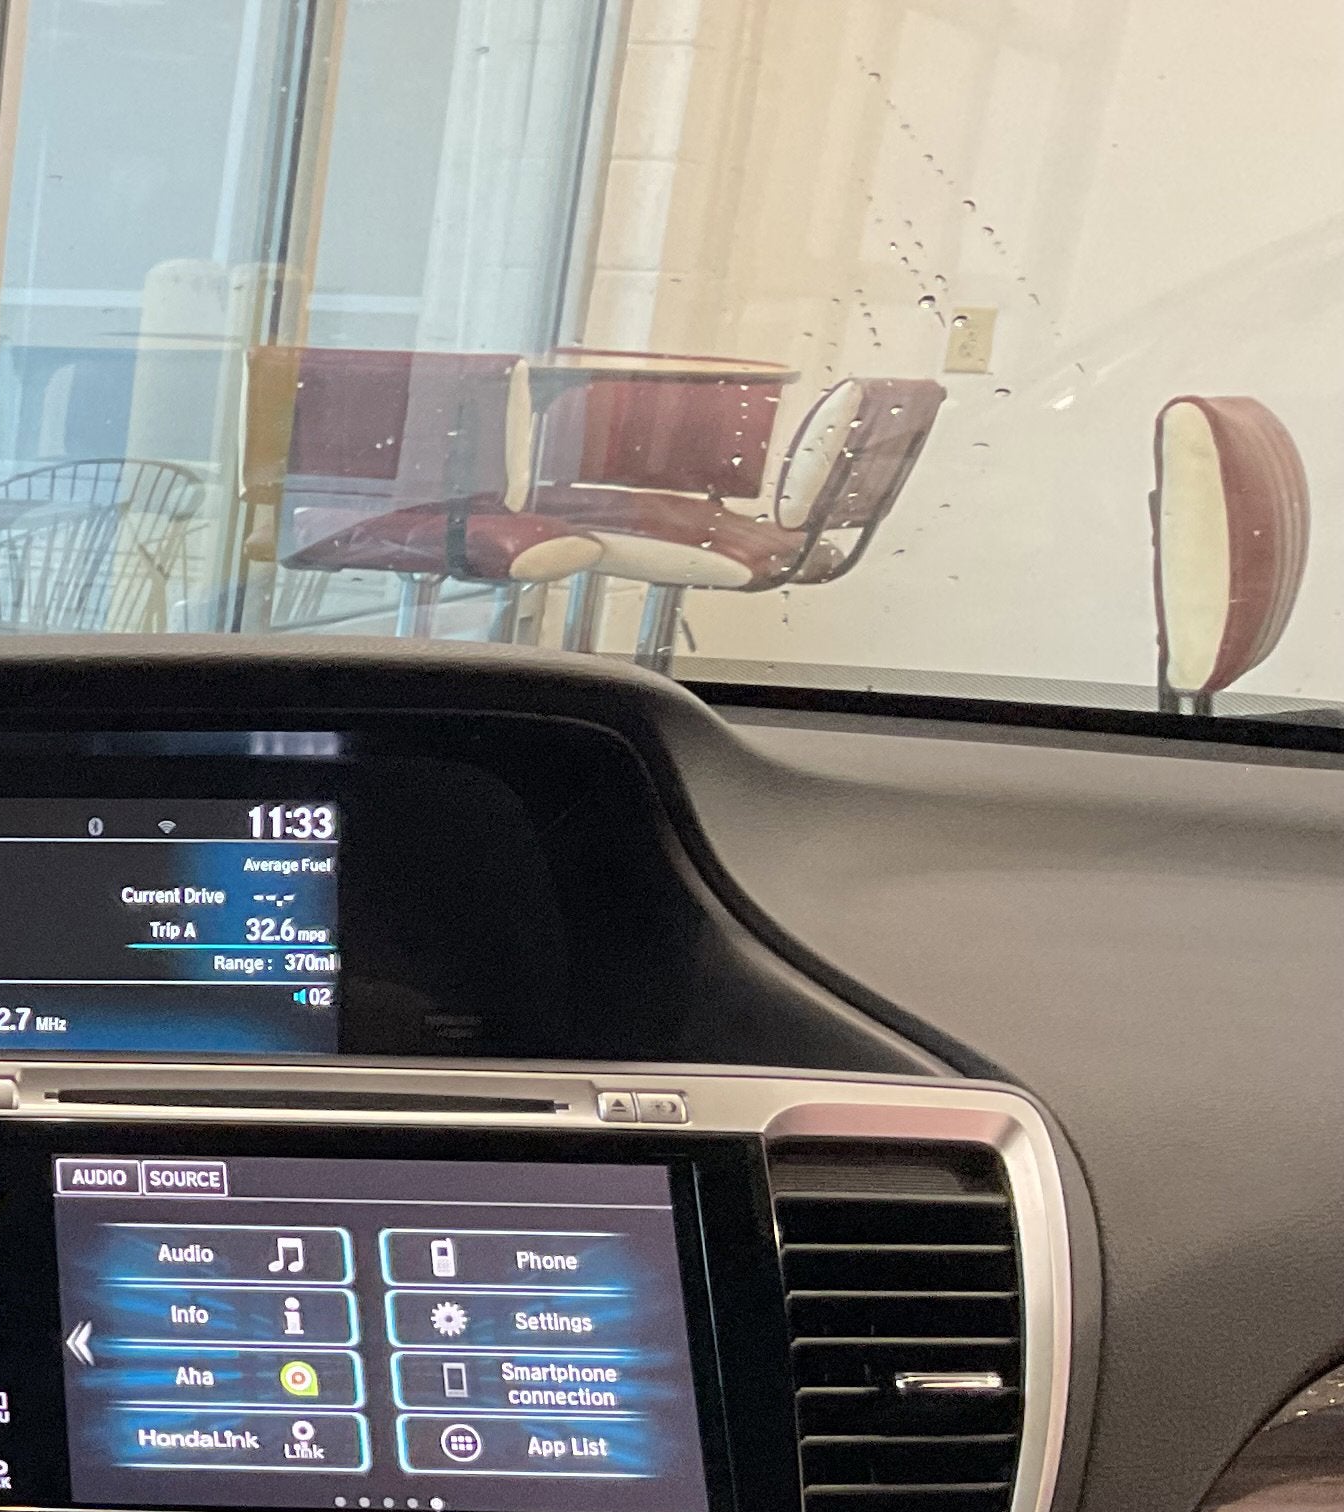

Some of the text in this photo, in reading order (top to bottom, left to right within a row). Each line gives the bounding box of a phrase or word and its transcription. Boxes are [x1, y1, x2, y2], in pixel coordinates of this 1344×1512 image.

[247, 806, 333, 838] 11:33
[243, 858, 331, 874] Average Fuel
[121, 887, 181, 904] Current
[184, 888, 224, 904] Drive
[150, 918, 326, 942] Trip A 32.6 mpg
[309, 988, 331, 1005] 02
[35, 1017, 67, 1031] MHz
[72, 1169, 127, 1186] AUDIO
[149, 1171, 221, 1188] SOURCE
[158, 1244, 214, 1263] Audio
[516, 1251, 578, 1270] Phone
[171, 1305, 209, 1324] Info
[515, 1312, 592, 1333] Settings
[175, 1367, 214, 1386] Aha
[501, 1362, 618, 1383] Smartphone
[508, 1388, 616, 1406] connection
[138, 1429, 260, 1449] HondaLink
[528, 1437, 608, 1456] App List
[284, 1443, 325, 1459] Link
